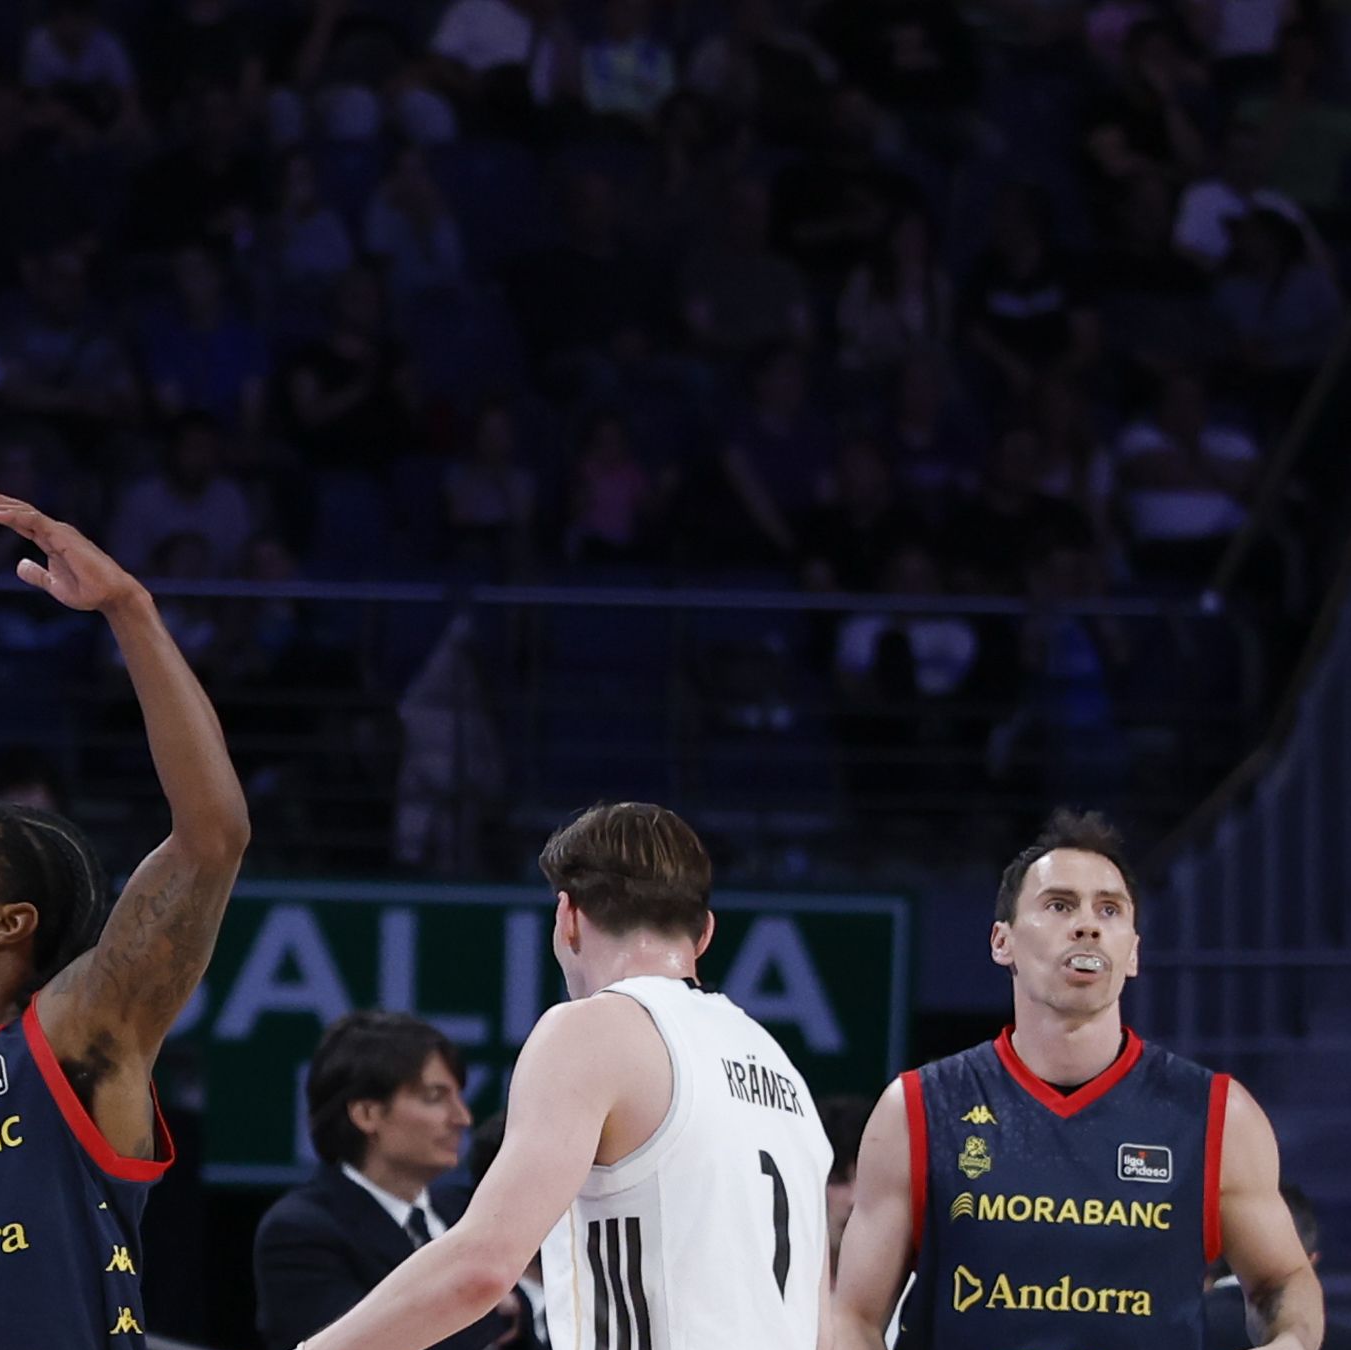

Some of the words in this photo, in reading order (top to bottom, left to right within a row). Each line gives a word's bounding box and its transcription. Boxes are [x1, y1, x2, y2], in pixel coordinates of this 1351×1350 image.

[170, 905, 846, 1051] ALIA
[722, 1055, 804, 1118] KRÄMER
[1123, 1153, 1145, 1168] liga
[1123, 1166, 1168, 1178] endesa
[758, 1149, 792, 1302] 1
[977, 1194, 1173, 1230] MORABANC
[986, 1275, 1152, 1317] Andorra
